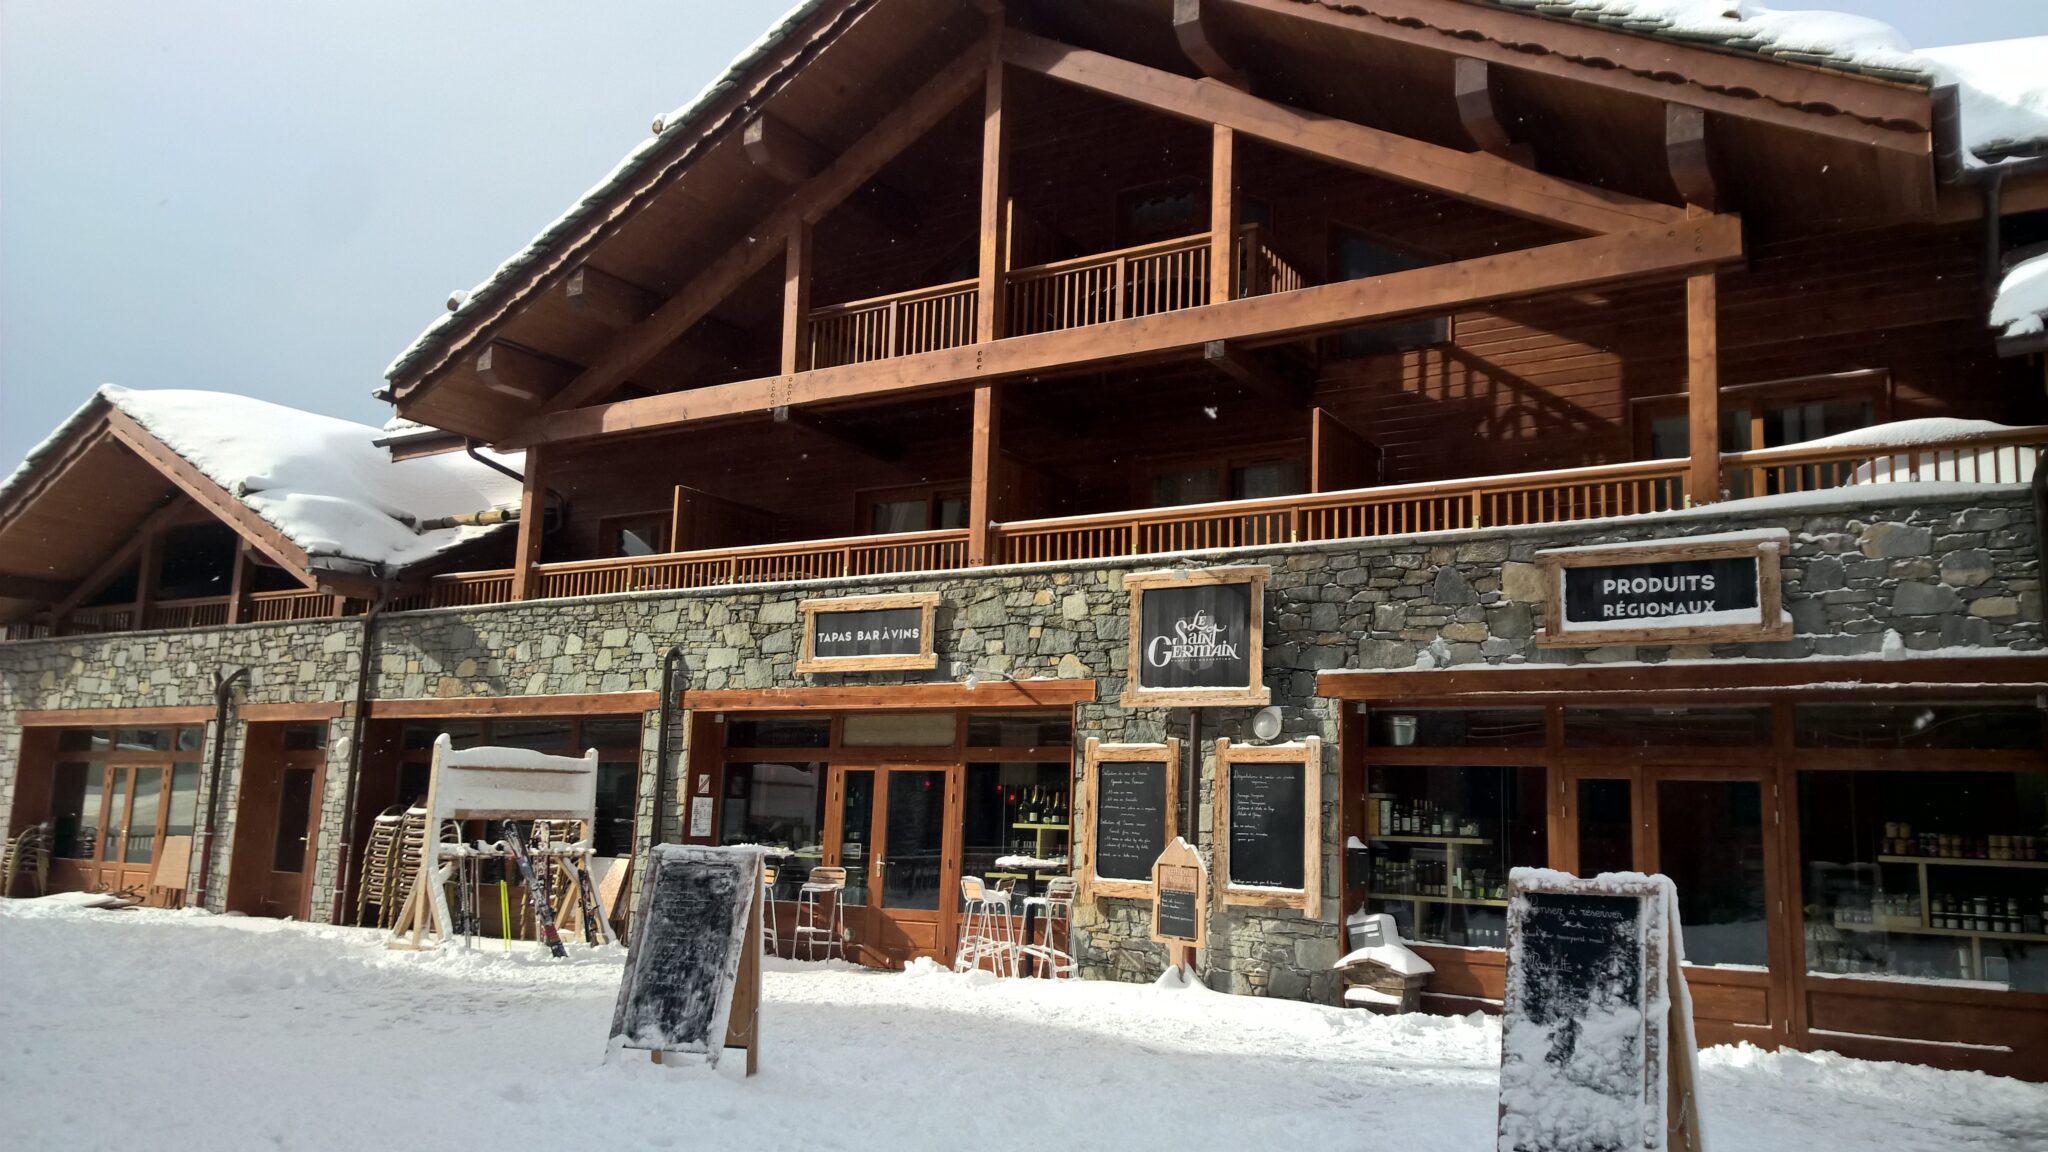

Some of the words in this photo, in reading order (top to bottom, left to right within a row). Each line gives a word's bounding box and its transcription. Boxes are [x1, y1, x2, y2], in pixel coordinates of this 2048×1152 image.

[1603, 574, 1716, 595] PRODUITS
[1603, 600, 1716, 617] RÉGIONAUX
[818, 631, 852, 643] TAPAS
[857, 630, 880, 641] BAR
[891, 627, 920, 640] VINS
